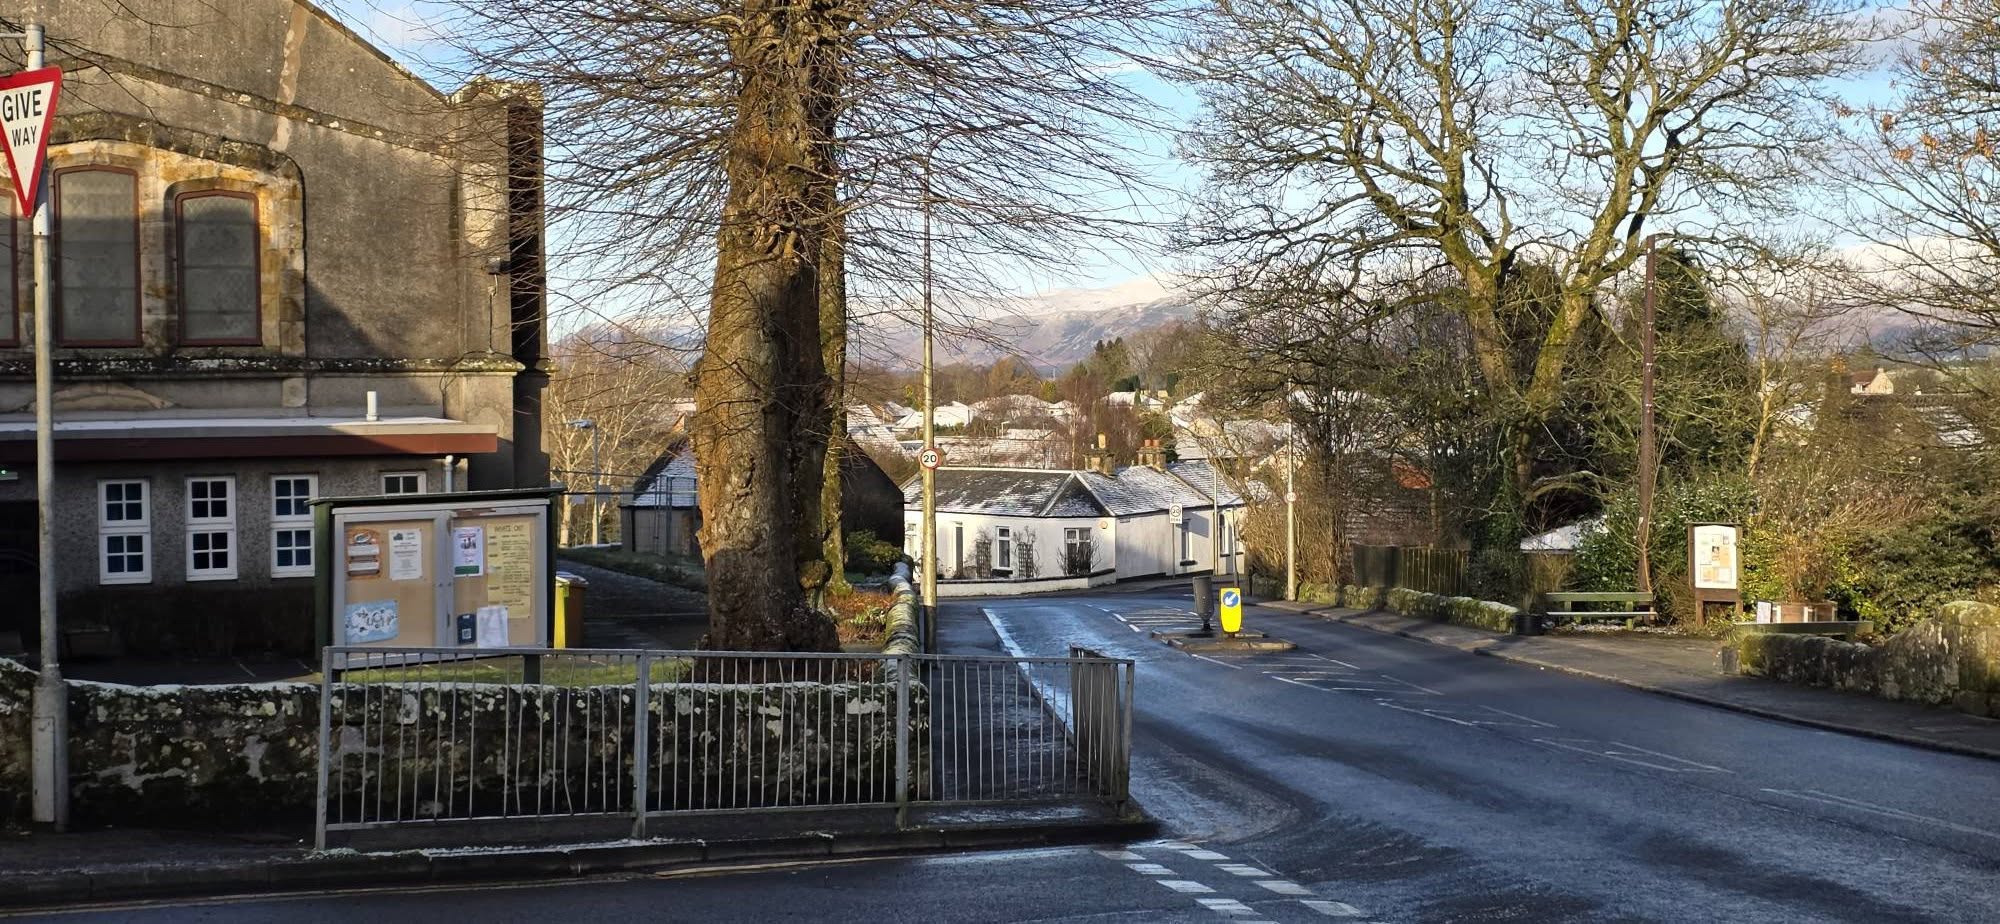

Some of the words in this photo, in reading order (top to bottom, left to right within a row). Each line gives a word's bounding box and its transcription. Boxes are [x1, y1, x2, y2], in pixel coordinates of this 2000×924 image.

[2, 90, 42, 122] GIVE
[12, 125, 37, 148] WAY
[923, 454, 937, 463] 20
